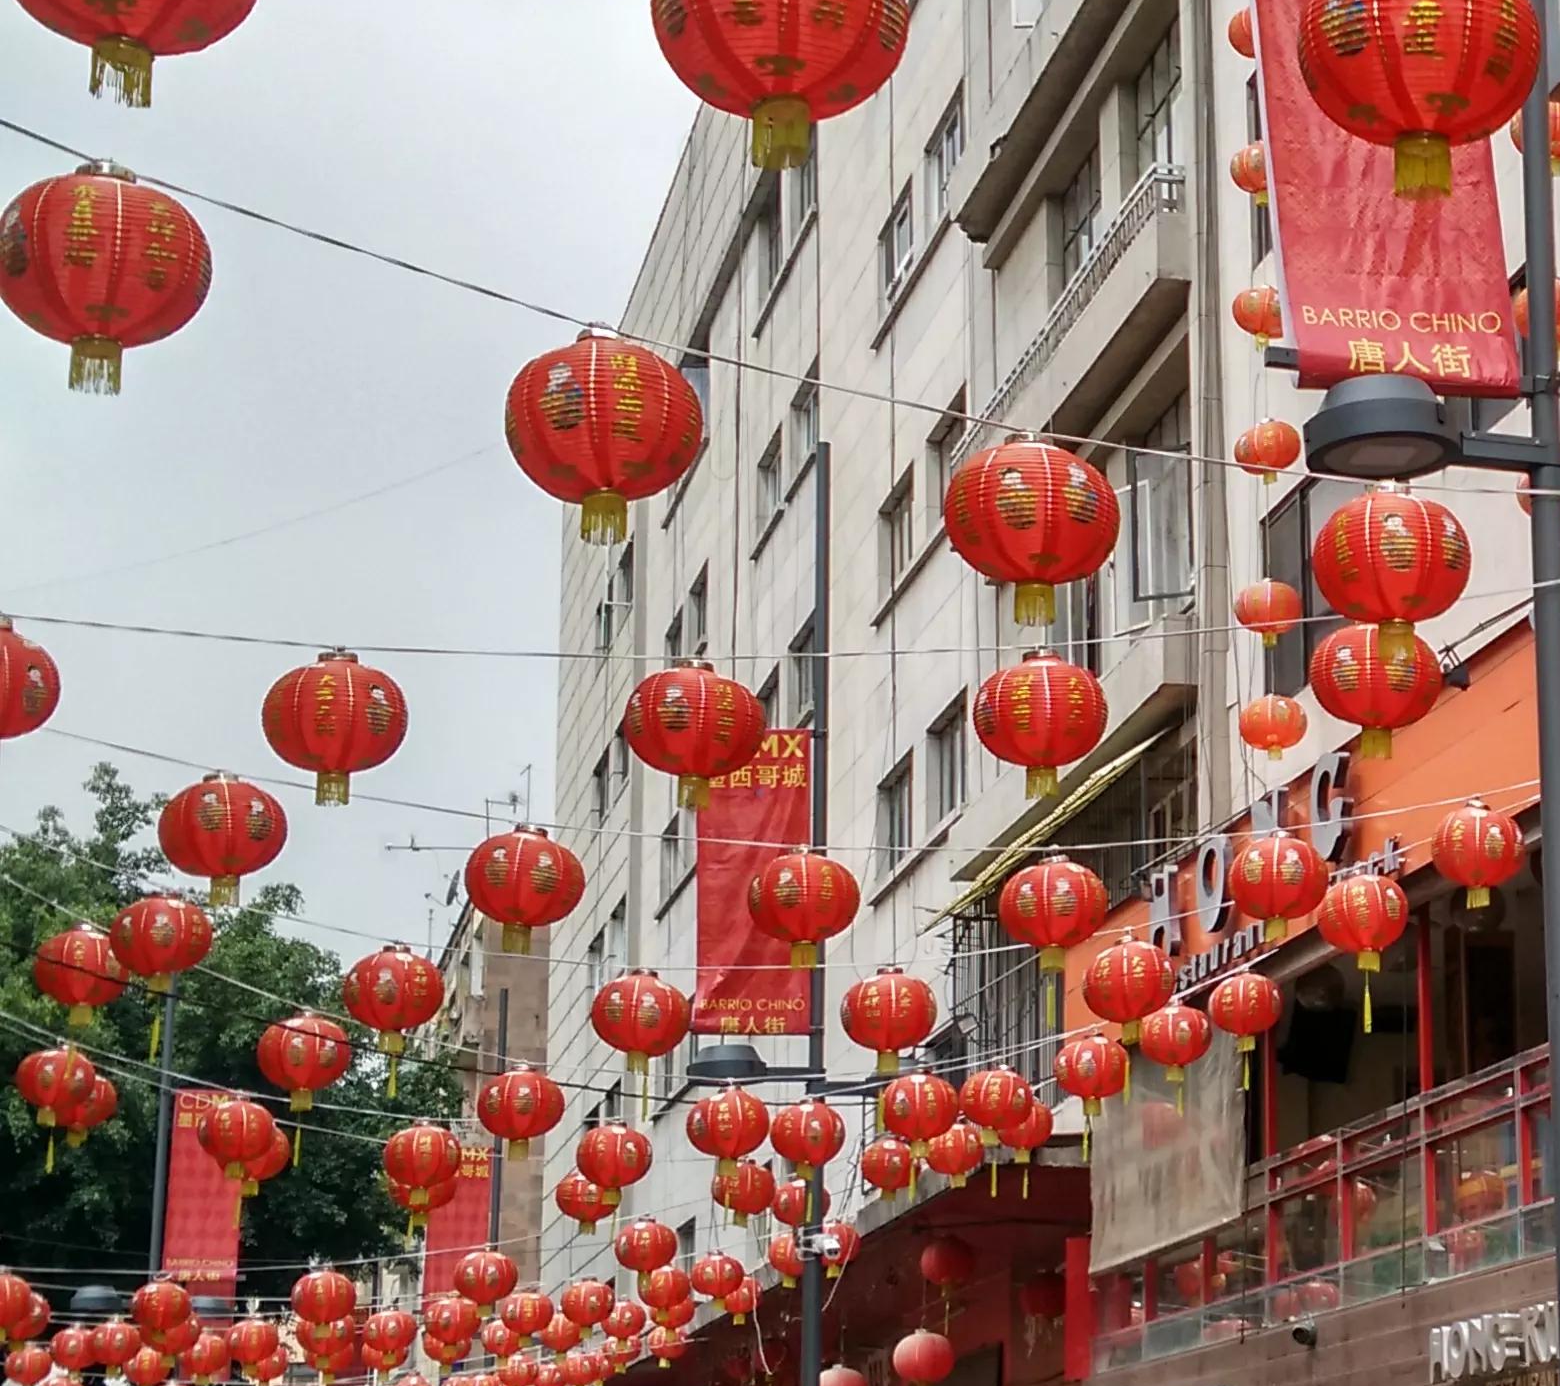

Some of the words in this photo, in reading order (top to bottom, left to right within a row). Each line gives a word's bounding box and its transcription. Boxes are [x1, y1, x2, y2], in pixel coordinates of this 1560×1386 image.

[1302, 305, 1401, 332] BARRIO
[1409, 310, 1501, 334] CHINO
[1348, 338, 1471, 378] 唐人街
[699, 999, 752, 1011] BARRIO
[756, 999, 805, 1011] CHINO
